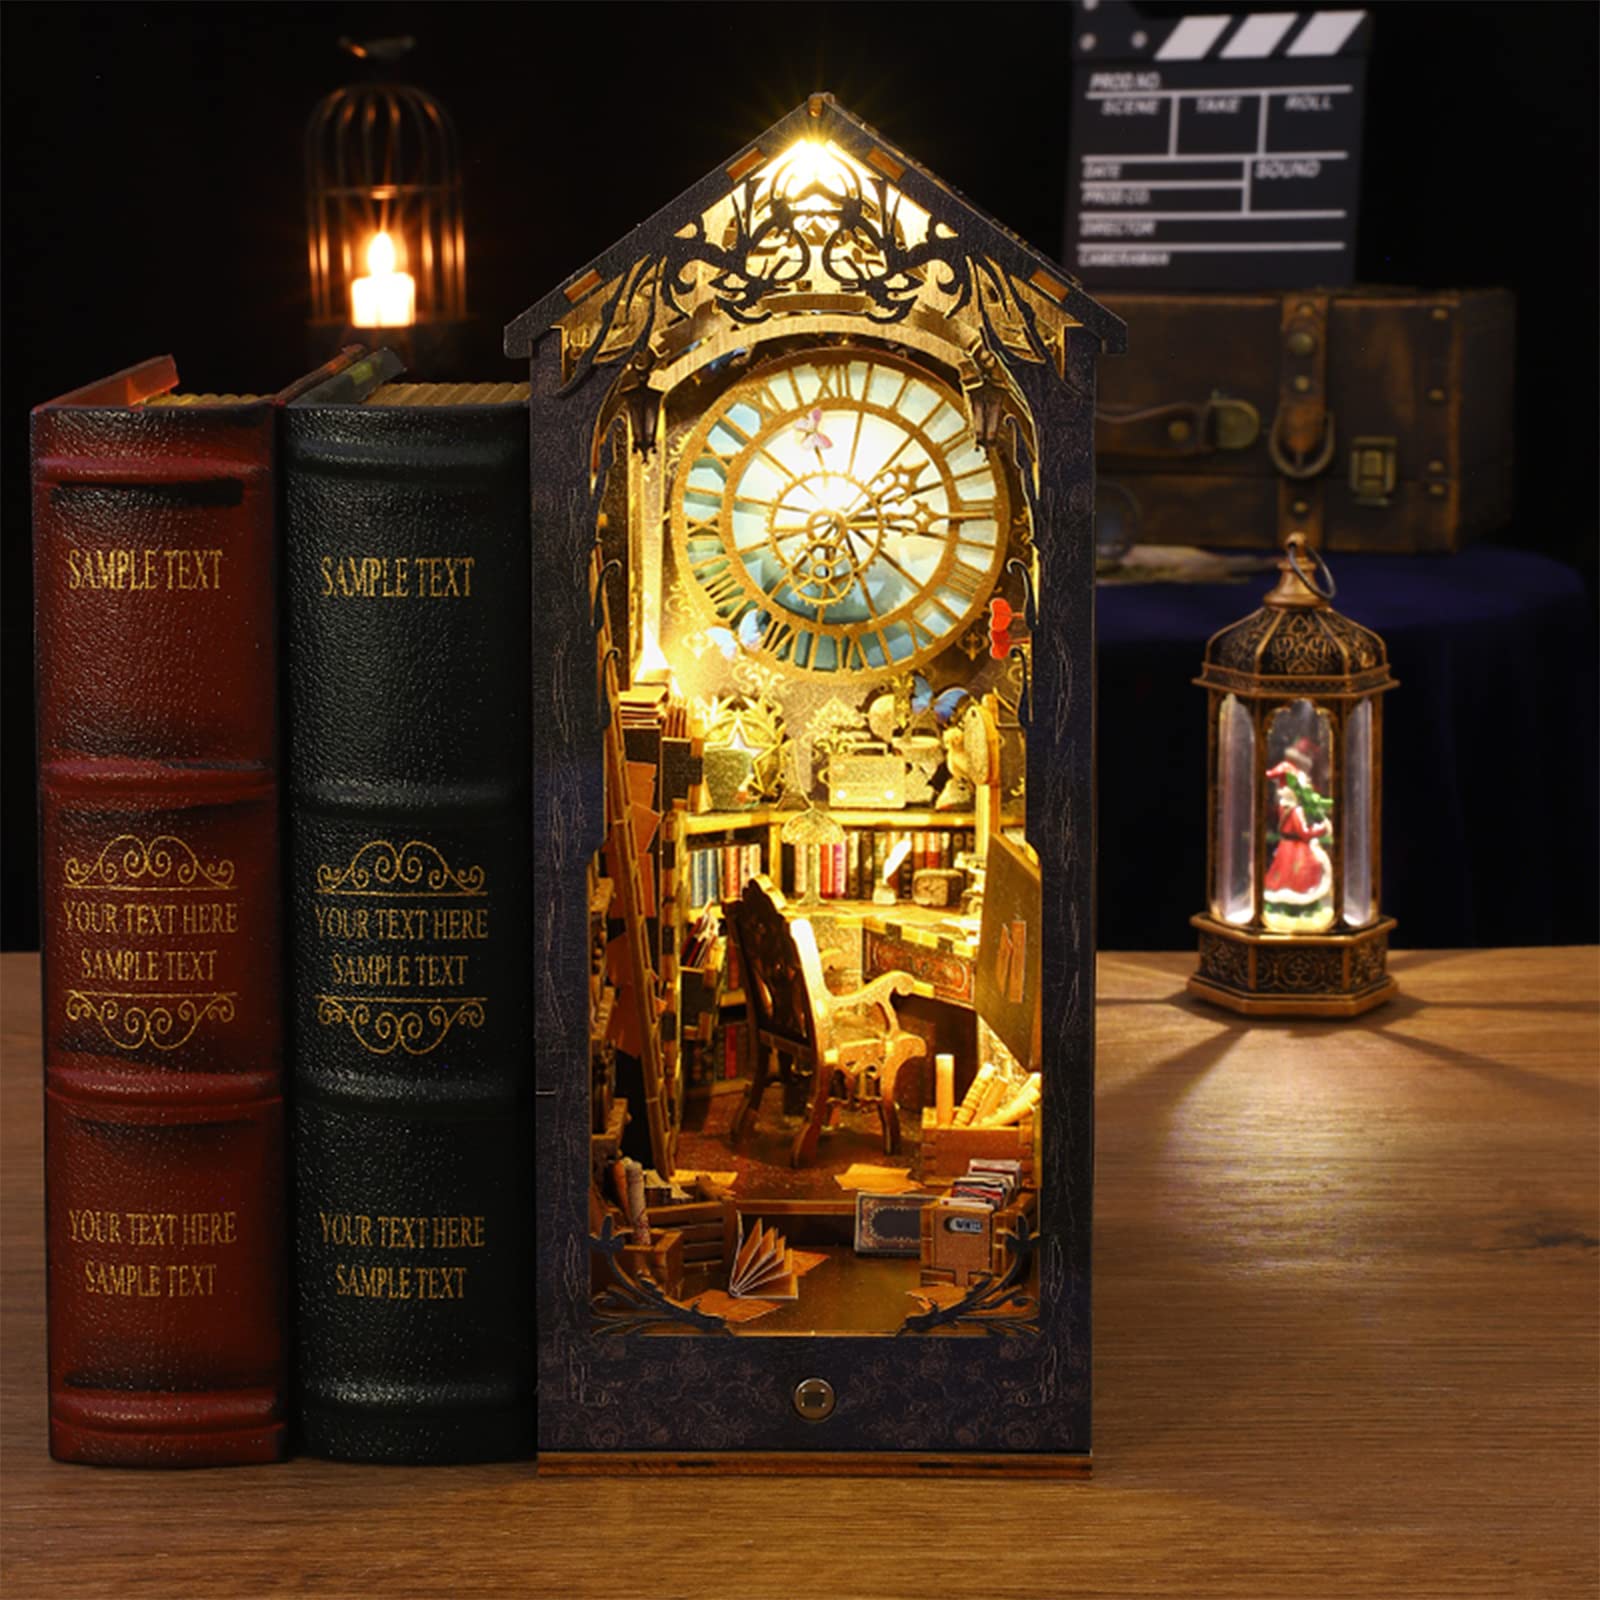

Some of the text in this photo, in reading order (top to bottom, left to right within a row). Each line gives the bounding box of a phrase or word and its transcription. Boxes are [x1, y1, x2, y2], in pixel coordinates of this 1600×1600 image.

[1101, 99, 1159, 115] SCENE
[1196, 97, 1240, 113] TAKE
[1285, 95, 1332, 111] ROLL
[1255, 160, 1321, 179] SOUND
[68, 548, 223, 591] SAMPLE TEXT
[321, 555, 475, 598] SAMPLE TEXT
[63, 900, 238, 935] YOUR TEXT HERE
[314, 905, 489, 940] YOUR TEXT HERE
[80, 948, 217, 982] SAMPLE TEXT
[332, 952, 469, 986] SAMPLE TEXT
[69, 1209, 238, 1246] YOUR TEXT HERE
[319, 1211, 486, 1248] YOUR TEXT HERE
[85, 1259, 217, 1297] SAMPLE TEXT
[336, 1263, 467, 1300] SAMPLE TEXT
